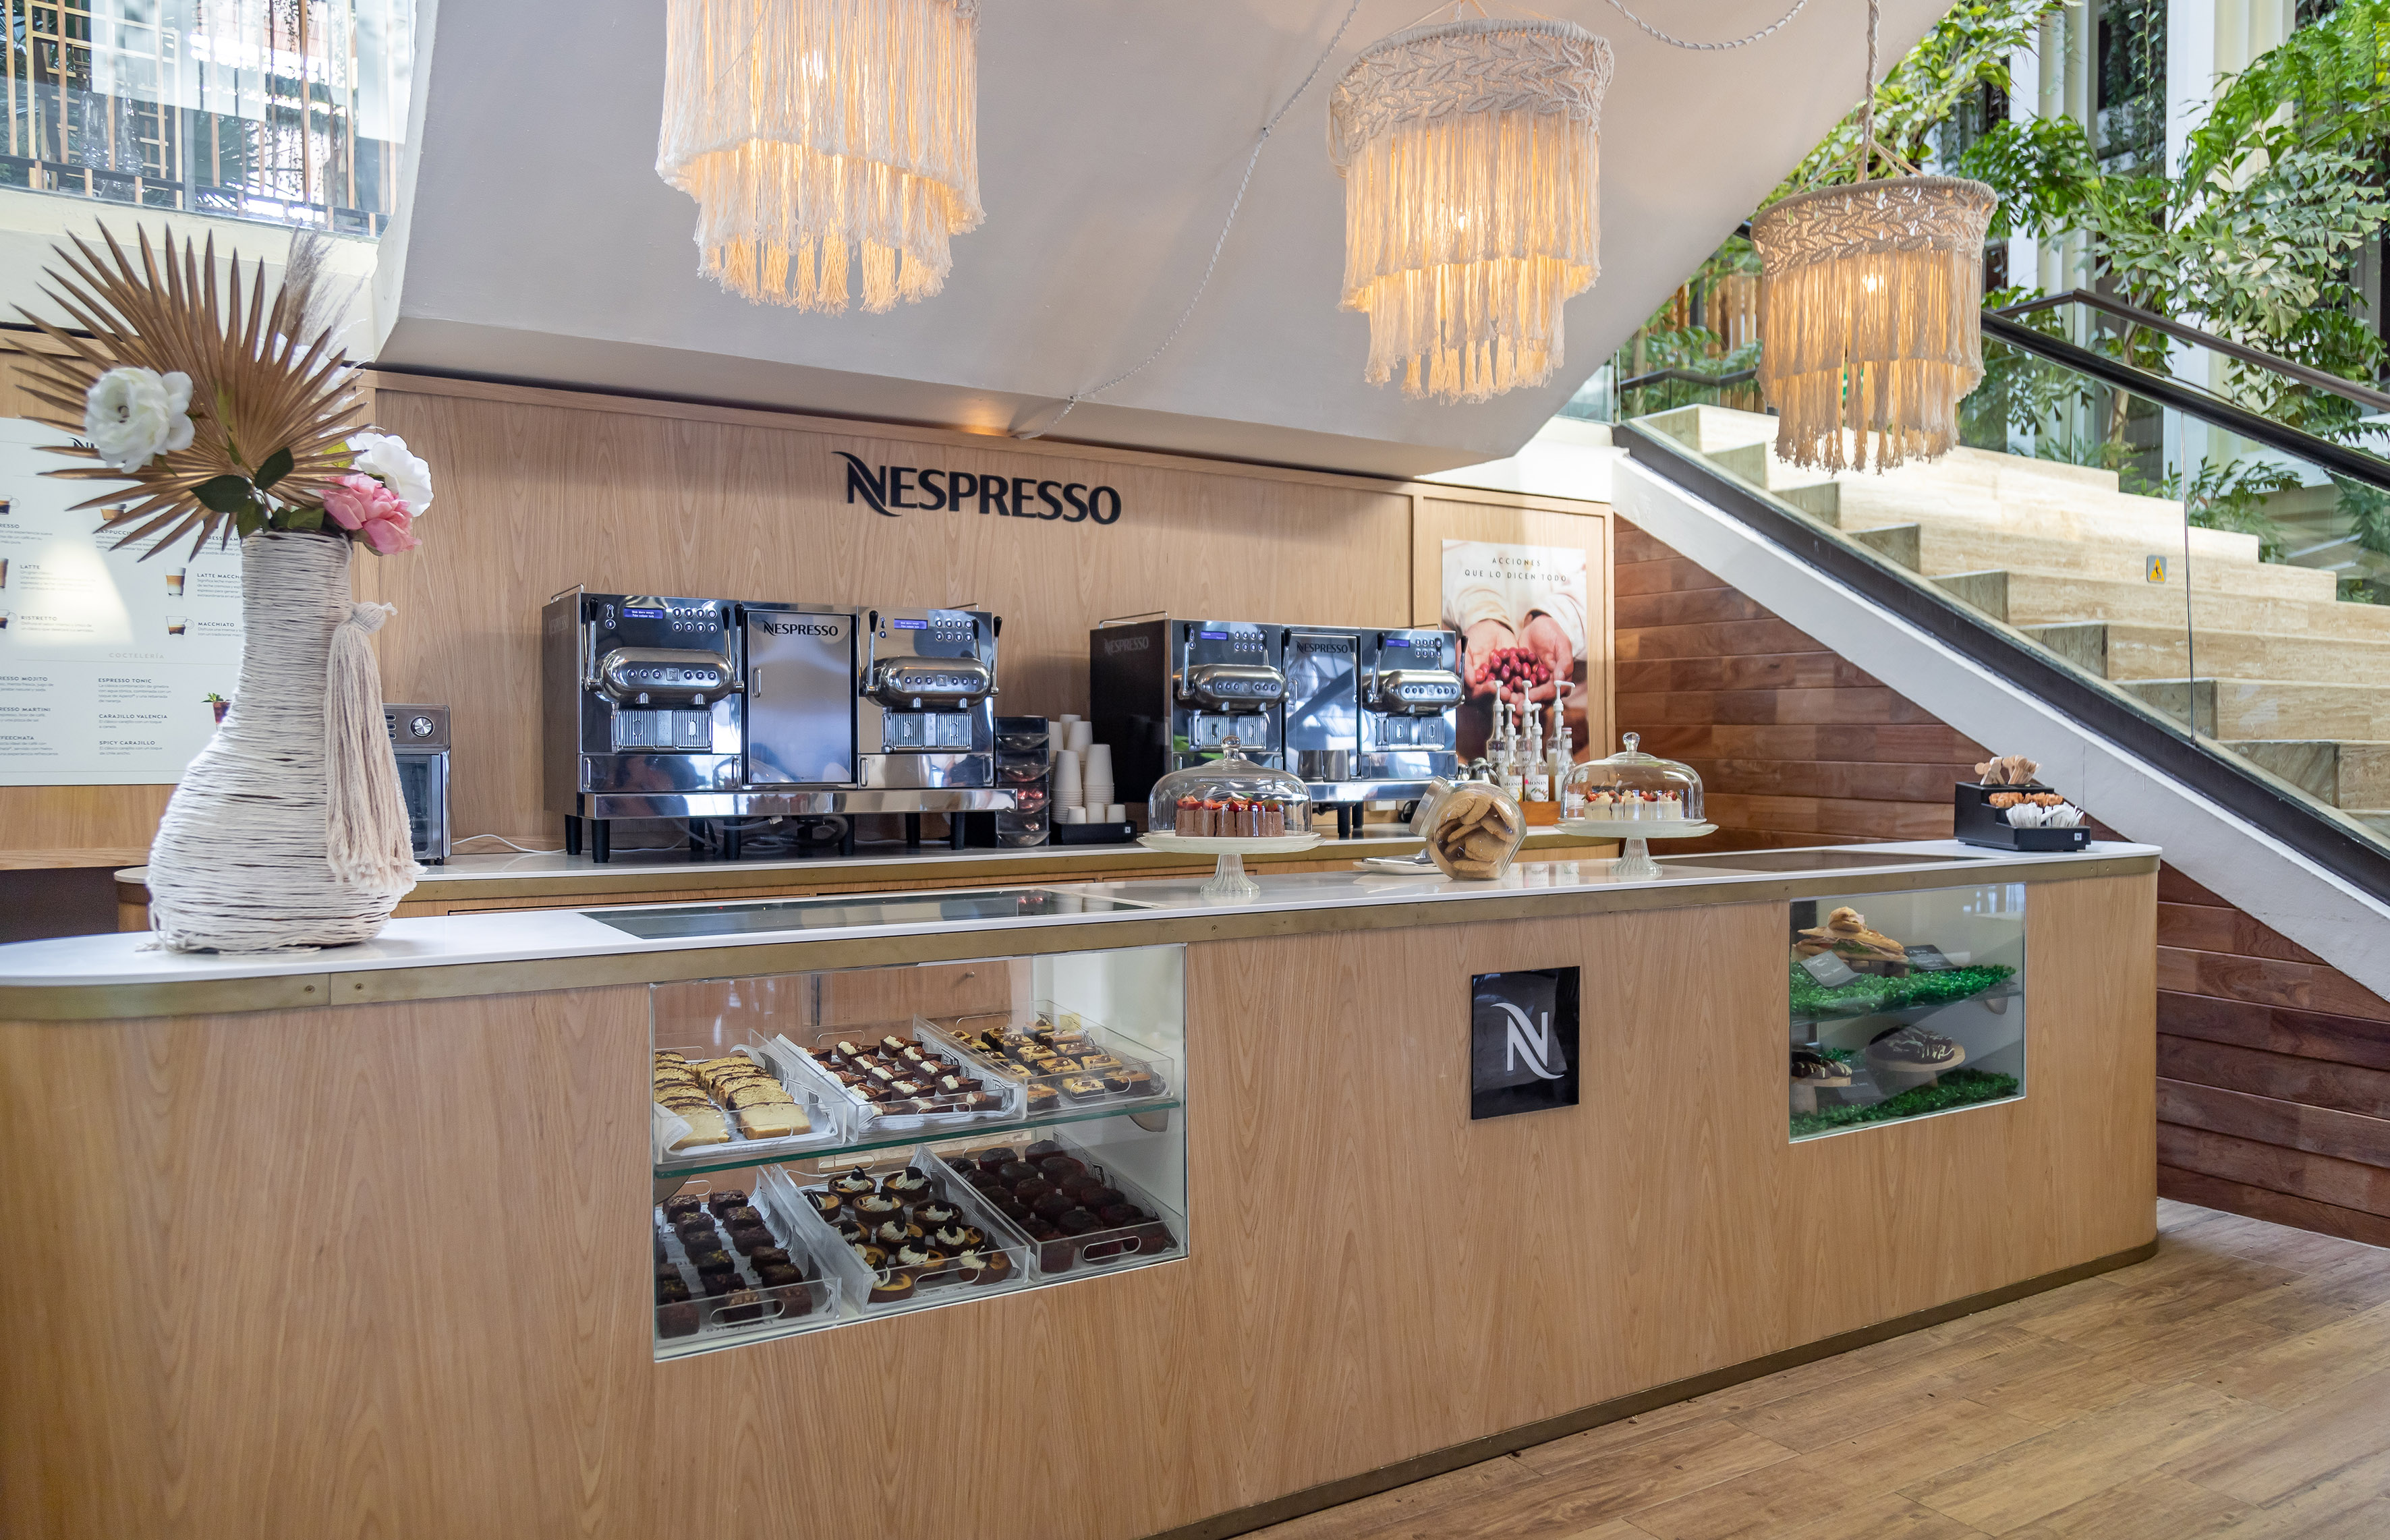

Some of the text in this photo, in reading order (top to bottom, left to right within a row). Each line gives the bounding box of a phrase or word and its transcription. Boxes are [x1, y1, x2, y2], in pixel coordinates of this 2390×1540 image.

[831, 451, 1122, 525] NESPRESSO
[1492, 557, 1541, 567] ACCIONES
[1464, 569, 1483, 577] QUE
[1507, 572, 1536, 580] DICEN
[1541, 574, 1566, 582] TODO
[762, 621, 838, 636] NESPRESSO
[1104, 636, 1149, 656] NESPRESSO
[1296, 641, 1348, 654] NESPRESSO
[1490, 1002, 1565, 1079] N
